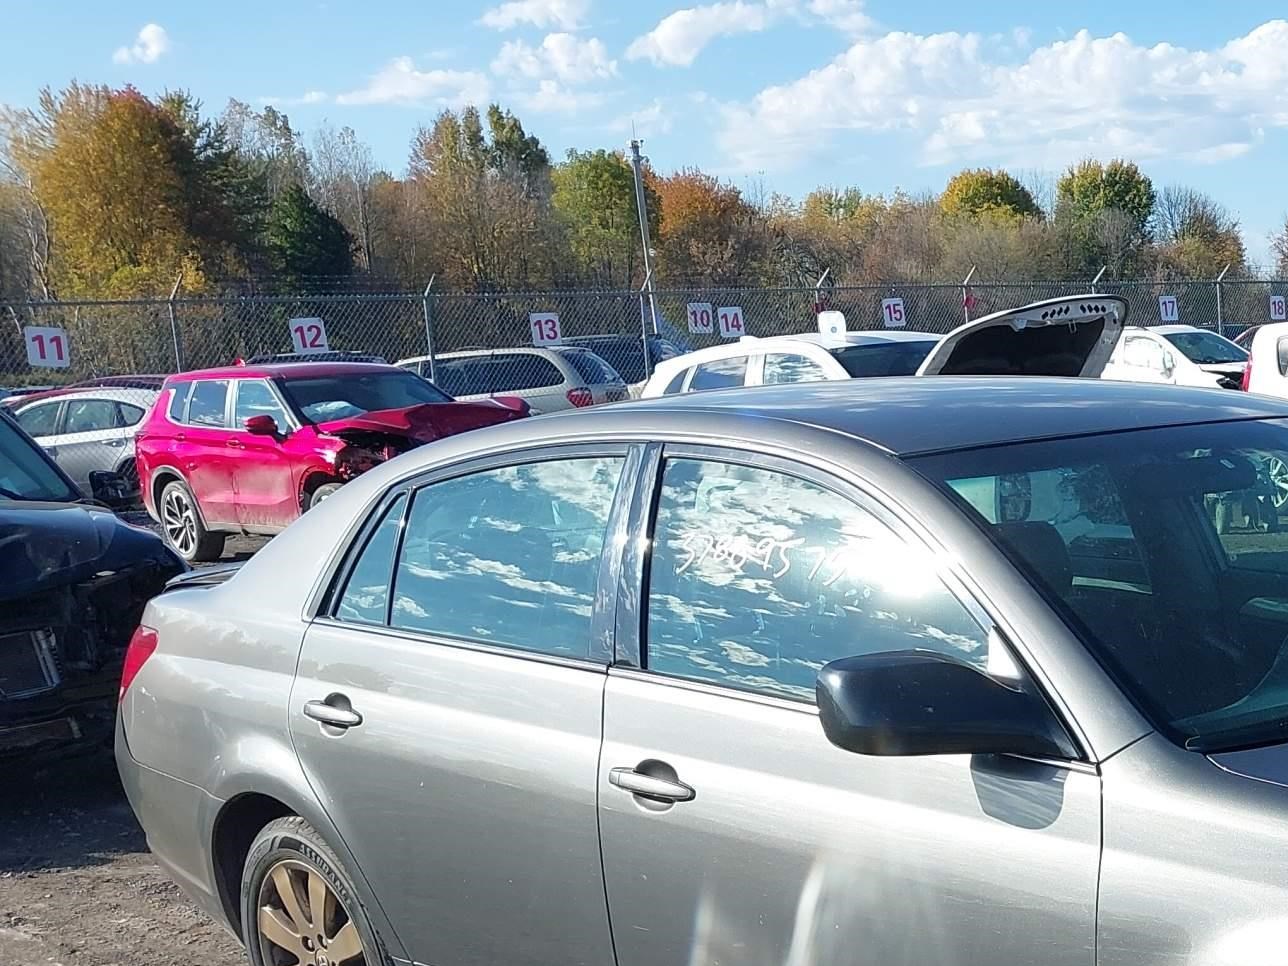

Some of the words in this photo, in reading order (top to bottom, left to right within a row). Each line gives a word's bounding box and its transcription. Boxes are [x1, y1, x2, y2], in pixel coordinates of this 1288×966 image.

[885, 303, 903, 322] 15
[1161, 300, 1175, 317] 17
[1272, 300, 1284, 316] 18
[690, 309, 710, 328] 10
[721, 312, 742, 333] 14
[294, 324, 325, 349] 12
[533, 319, 558, 341] 13
[31, 334, 64, 361] 11
